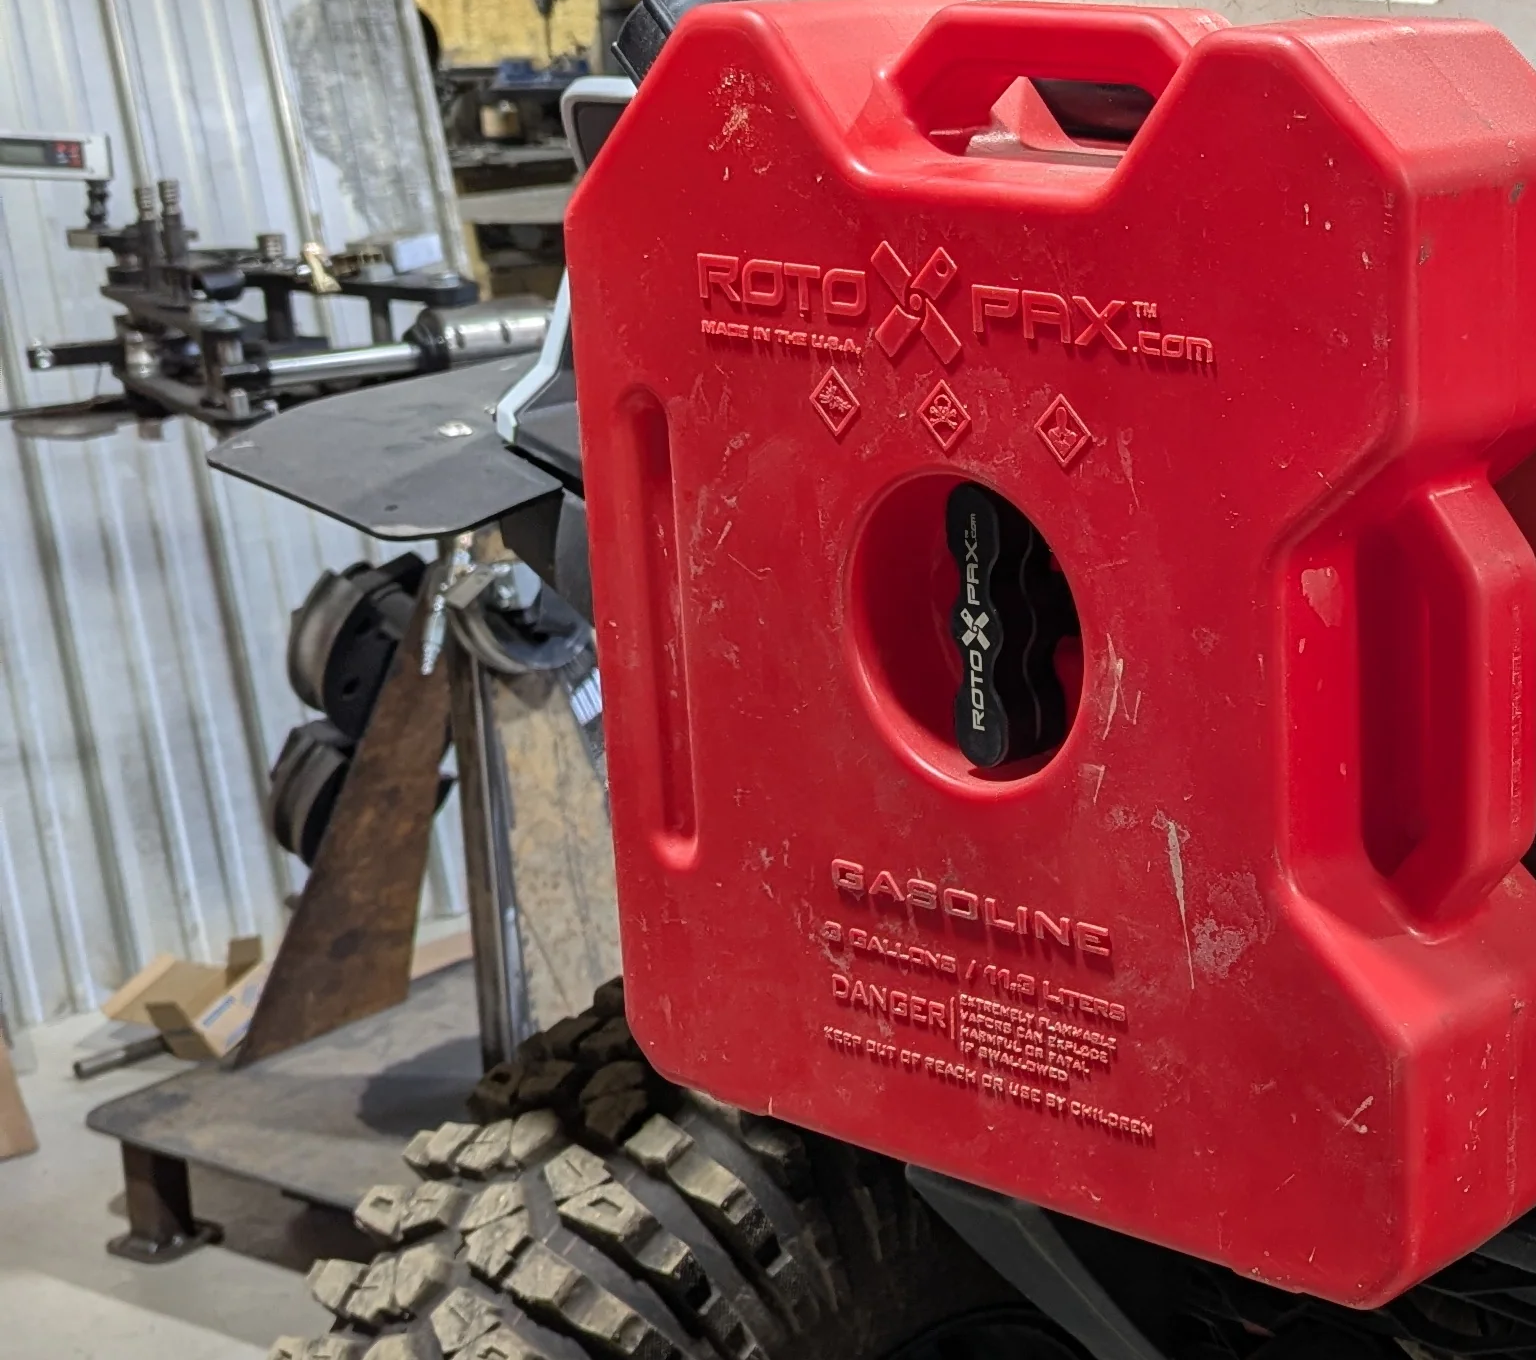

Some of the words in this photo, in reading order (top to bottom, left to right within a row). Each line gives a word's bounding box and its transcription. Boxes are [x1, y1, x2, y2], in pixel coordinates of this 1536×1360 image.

[696, 251, 867, 318] ROTO
[971, 282, 1128, 352] PAX
[700, 318, 750, 339] MADE
[752, 325, 772, 342] IN
[774, 327, 809, 348] THE
[811, 332, 863, 355] U.S.A.
[1131, 329, 1214, 364] .com
[969, 648, 986, 732] ROTO
[831, 858, 1110, 957] GASOLINE
[820, 919, 842, 943] 3
[849, 927, 957, 975] GALLONS
[983, 964, 1036, 997] 11.3
[1042, 979, 1127, 1023] LITERS
[831, 972, 947, 1030] DANGER
[959, 993, 1035, 1025] EXTREMELY
[1038, 1016, 1117, 1051] FLAMMABLE
[959, 1008, 1012, 1035] VAPORS
[1016, 1025, 1044, 1044] CAN
[1048, 1034, 1109, 1065] EXPLODE
[960, 1024, 1023, 1053] HARMFUL
[1024, 1043, 1044, 1059] OR
[1048, 1050, 1091, 1074] FATAL
[960, 1040, 975, 1053] IF
[978, 1045, 1069, 1082] SWALLOWED
[823, 1025, 863, 1048] KEEP
[866, 1039, 897, 1060] OUT
[900, 1048, 921, 1066] OF
[924, 1055, 977, 1084] REACH
[981, 1072, 1004, 1092] OR
[1008, 1081, 1042, 1104] USE
[1045, 1092, 1067, 1111] BY
[1069, 1099, 1154, 1138] CHILDREN
